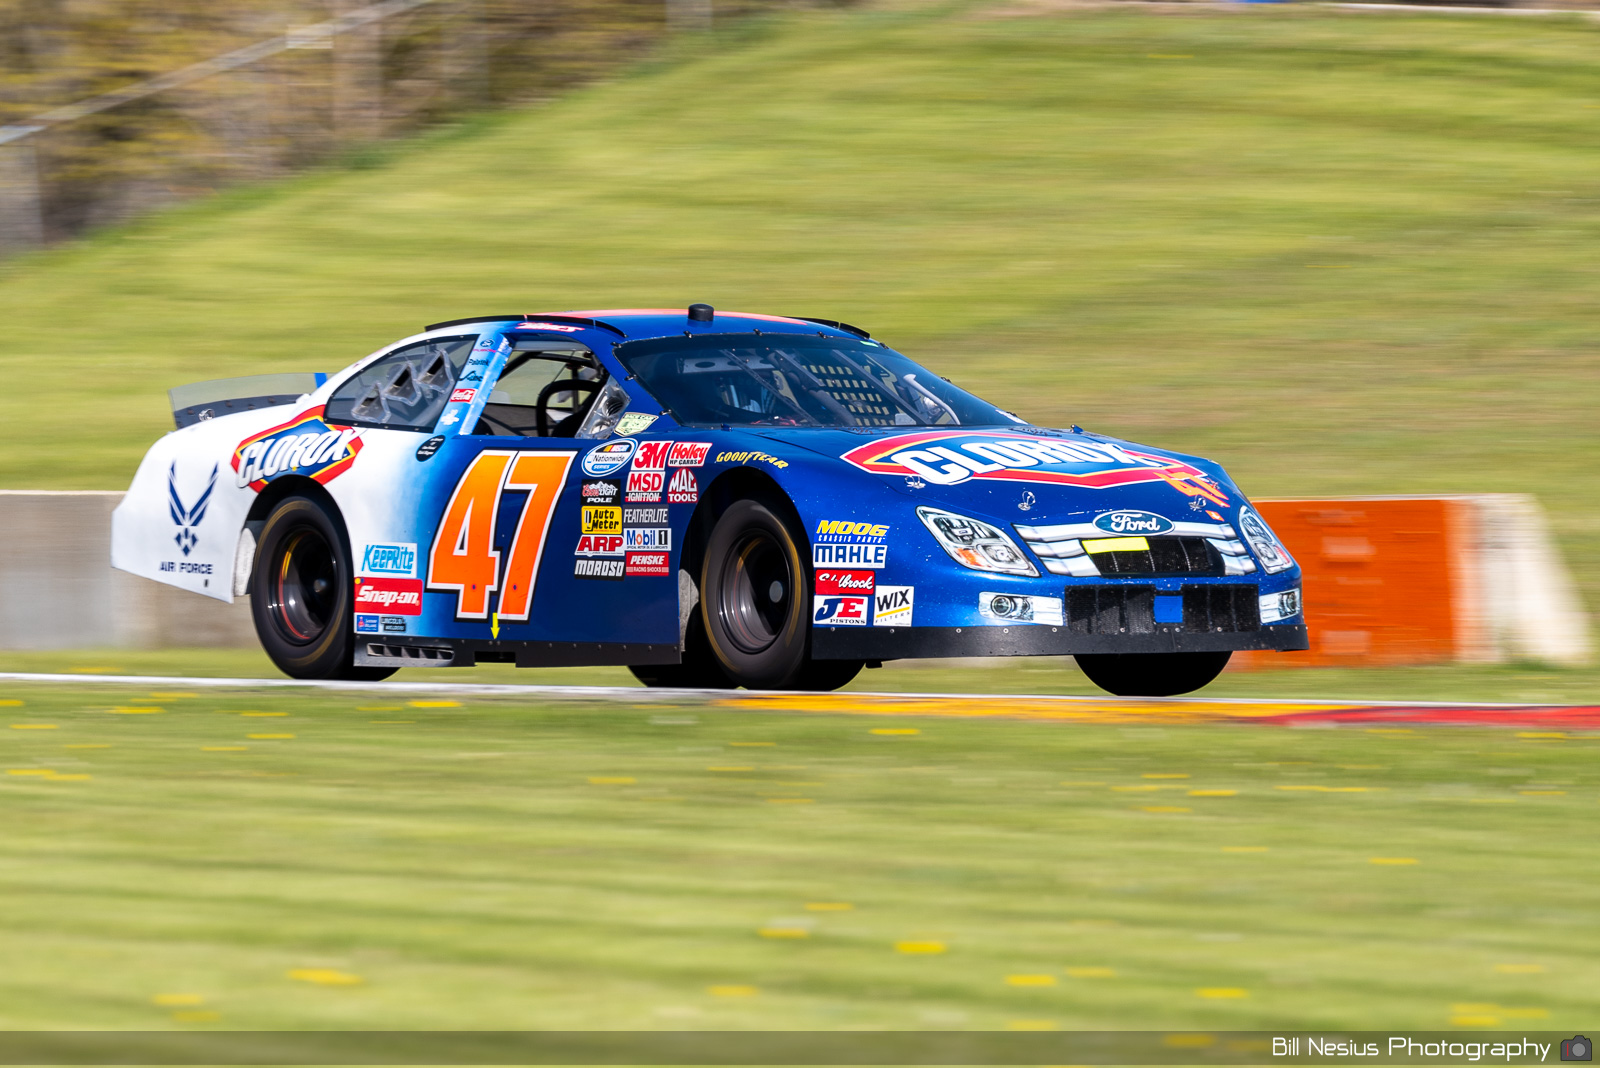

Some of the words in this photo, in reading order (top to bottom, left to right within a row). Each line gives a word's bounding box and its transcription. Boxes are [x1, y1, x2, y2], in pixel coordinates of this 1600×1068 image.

[236, 428, 366, 489] CLOROX
[634, 442, 672, 469] 3M
[670, 443, 709, 464] Holley
[716, 451, 789, 469] GOODYEAR
[890, 440, 1164, 485] CLOROX
[628, 473, 663, 492] MSD
[668, 468, 697, 493] MAC
[628, 492, 660, 502] IGNITION
[668, 493, 697, 502] TOOLS
[593, 509, 615, 519] Auto
[624, 508, 669, 523] FEATHERLITE
[1111, 513, 1160, 532] Ford
[592, 519, 620, 530] Meter
[816, 520, 890, 536] MOOG
[426, 449, 578, 622] 47
[577, 536, 624, 552] ARP
[626, 529, 656, 546] Mobil
[818, 534, 852, 542] CHASSIS
[856, 535, 883, 543] PARTS
[630, 555, 666, 565] PENSKE
[815, 545, 886, 563] MAHLE
[159, 561, 177, 572] AIR
[179, 562, 214, 574] FORCE
[574, 559, 625, 577] MOROSO
[877, 588, 910, 612] WIX
[815, 597, 865, 622] JE
[875, 611, 910, 623] FILTERS
